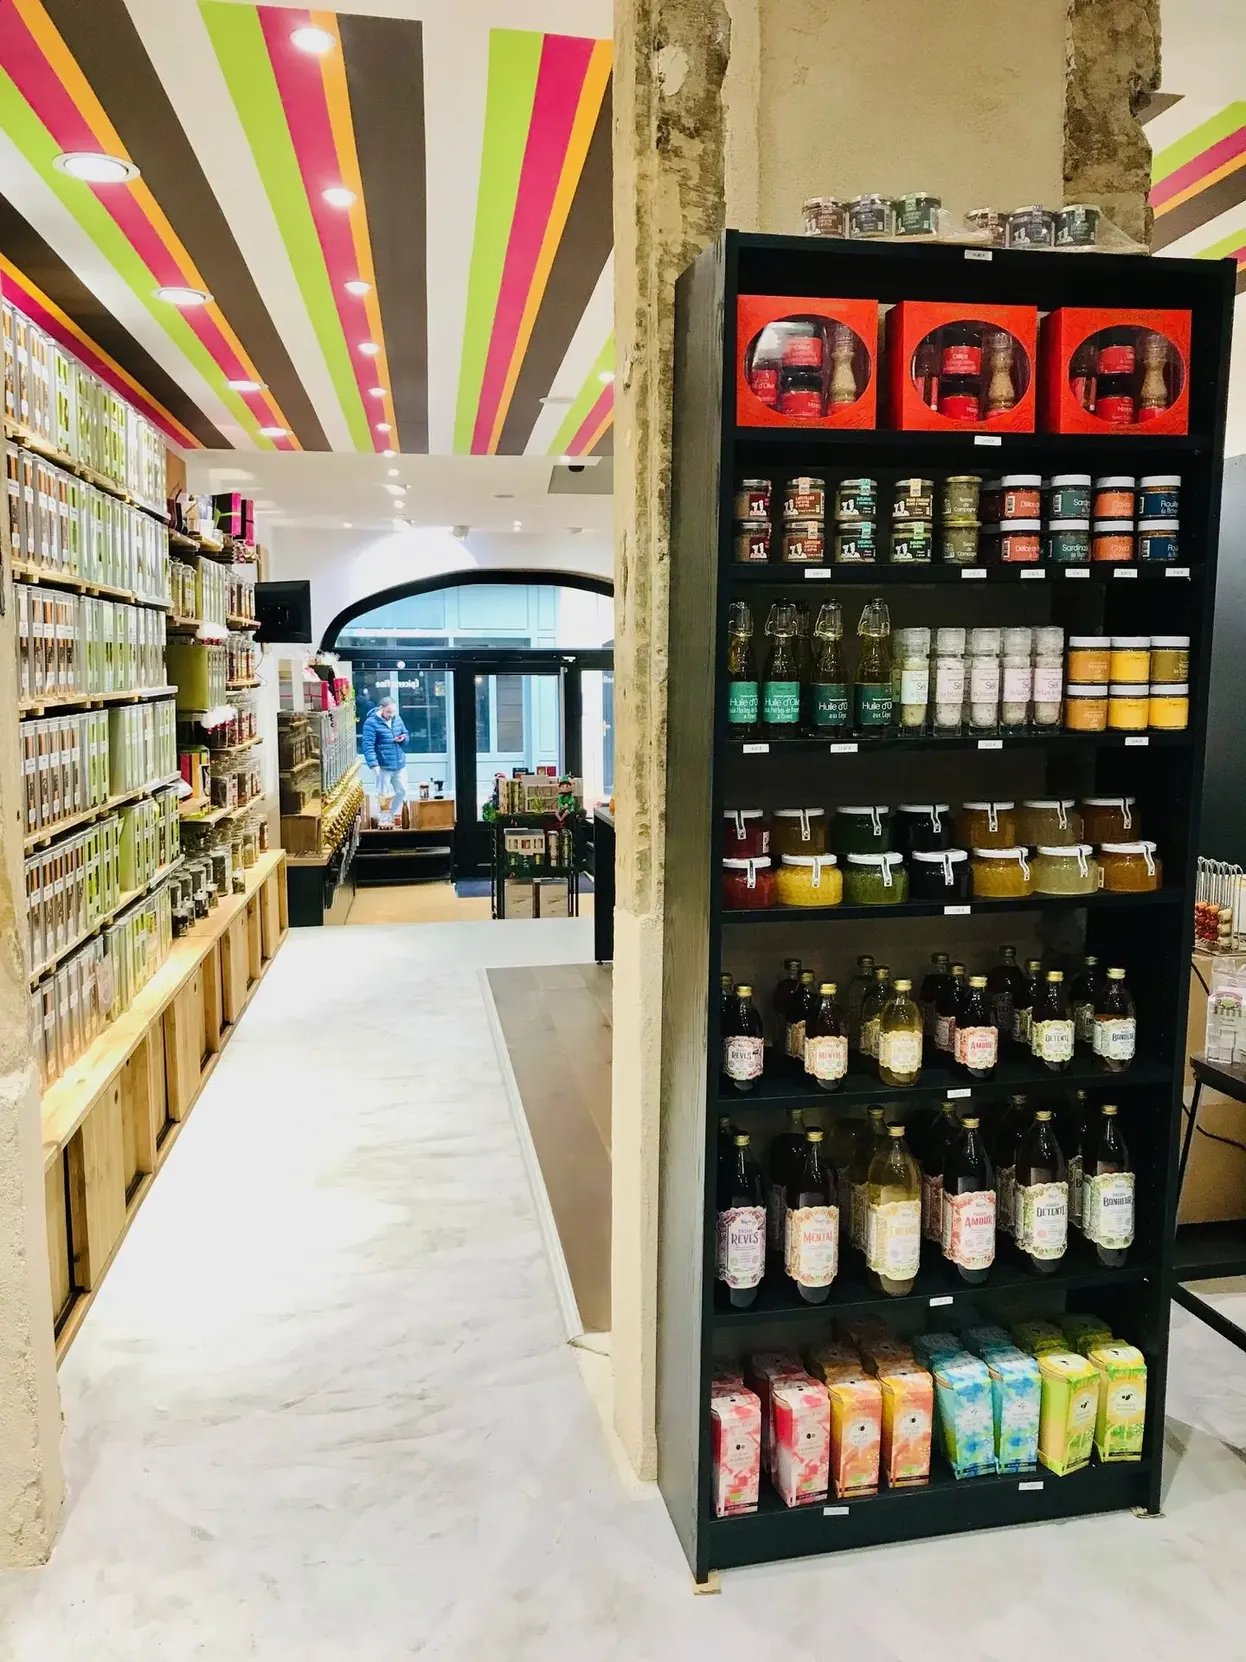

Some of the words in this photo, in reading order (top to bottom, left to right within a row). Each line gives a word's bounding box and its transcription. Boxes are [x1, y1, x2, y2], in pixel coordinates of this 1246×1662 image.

[729, 698, 748, 706] Huile
[765, 698, 782, 706] Huile
[818, 702, 837, 711] Huile
[862, 702, 880, 710] Huile
[970, 1041, 993, 1050] AMOUR
[1103, 1196, 1132, 1207] BONHEUR
[964, 1215, 993, 1227] AMOUR
